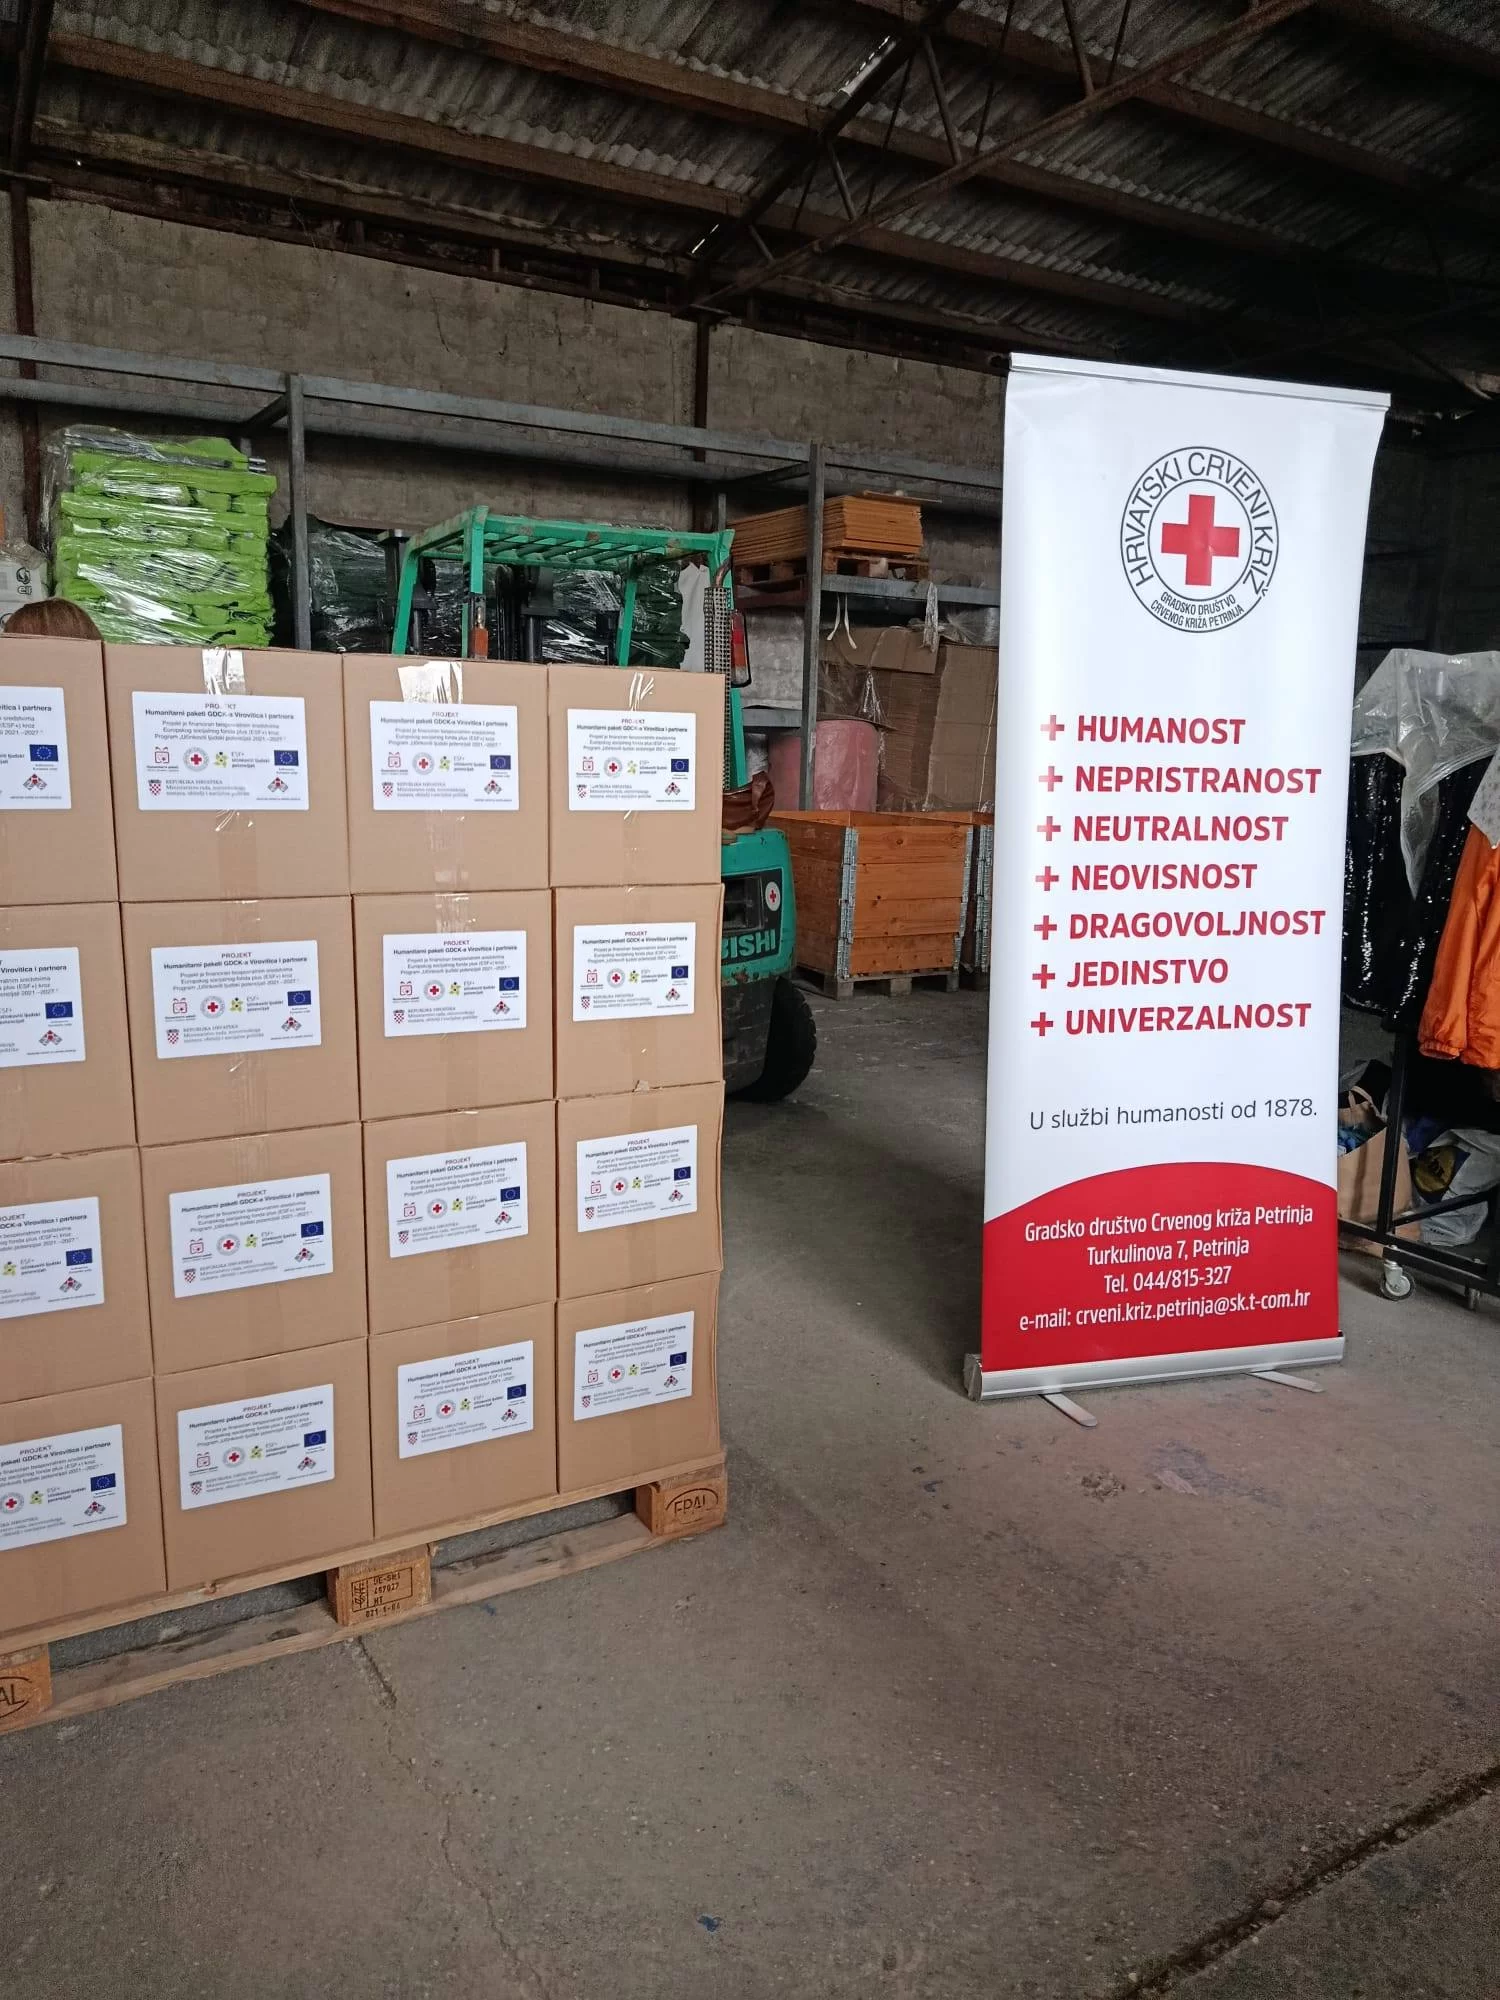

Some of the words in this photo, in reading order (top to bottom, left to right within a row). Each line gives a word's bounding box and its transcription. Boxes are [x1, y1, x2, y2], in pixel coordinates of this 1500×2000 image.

[1125, 457, 1182, 587] HRVATSKI
[1188, 452, 1270, 520] CRVENI
[1242, 526, 1274, 598] KRIŽ
[1150, 600, 1184, 627] CRVENOG
[1184, 615, 1208, 629] KRIŽA
[1209, 604, 1245, 627] PETRINJA
[1160, 591, 1196, 615] GRADSKO
[1198, 594, 1236, 615] DRUŠTVO
[1077, 715, 1246, 744] HUMANOST
[1075, 766, 1322, 794] NEPRISTRANOST
[1073, 815, 1289, 842] NEUTRALNOST
[1071, 863, 1258, 891] NEOVISNOST
[1069, 910, 1326, 940] DRAGOVOLJNOST
[1067, 958, 1229, 987] JEDINSTVO
[1066, 1003, 1311, 1035] UNIVERZALNOST
[1030, 1111, 1044, 1130] U
[1051, 1107, 1109, 1129] službi
[1117, 1101, 1224, 1125] humanosti
[1231, 1100, 1257, 1118] od
[1265, 1098, 1318, 1117] 1878.
[1025, 1220, 1085, 1242] Gradsko
[1089, 1216, 1147, 1237] društvo
[1151, 1212, 1212, 1233] Crvenog
[1216, 1207, 1251, 1228] križa
[1255, 1204, 1313, 1226] Petrinja
[1087, 1241, 1173, 1266] Turkulinova
[1177, 1240, 1189, 1262] 7,
[1192, 1236, 1250, 1259] Petrinja
[1104, 1274, 1129, 1294] Tel.
[1133, 1265, 1233, 1293] 044/815-327
[1019, 1308, 1072, 1331] e-mail:
[1076, 1289, 1311, 1326] crveni.kriz.petrinja@sk.t-com.hr
